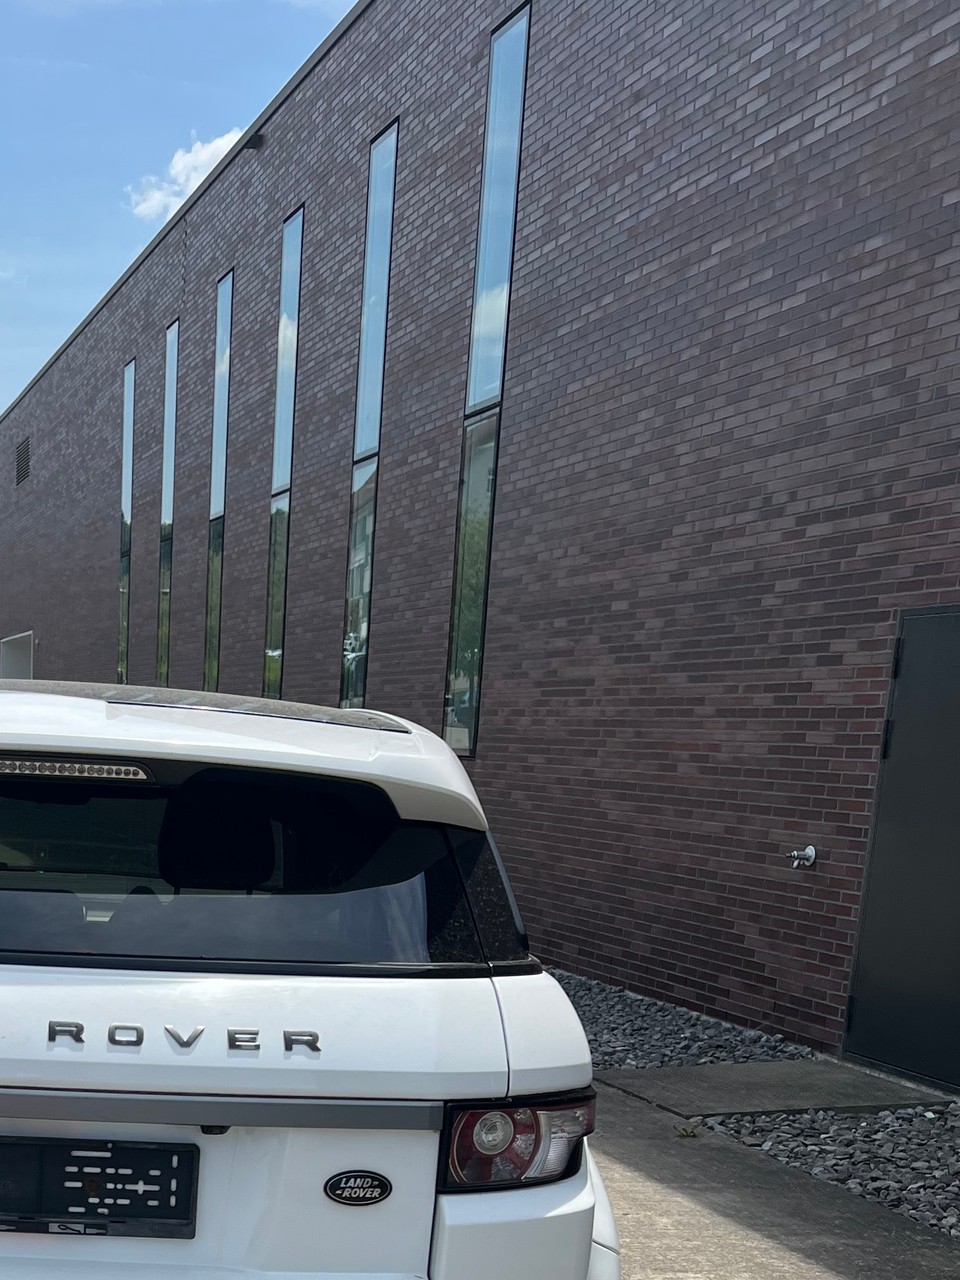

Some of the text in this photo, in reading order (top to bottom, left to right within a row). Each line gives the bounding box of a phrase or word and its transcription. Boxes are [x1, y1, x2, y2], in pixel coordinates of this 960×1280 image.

[47, 1020, 323, 1053] ROVER
[340, 1178, 372, 1188] LAND
[342, 1188, 382, 1198] ROVER
